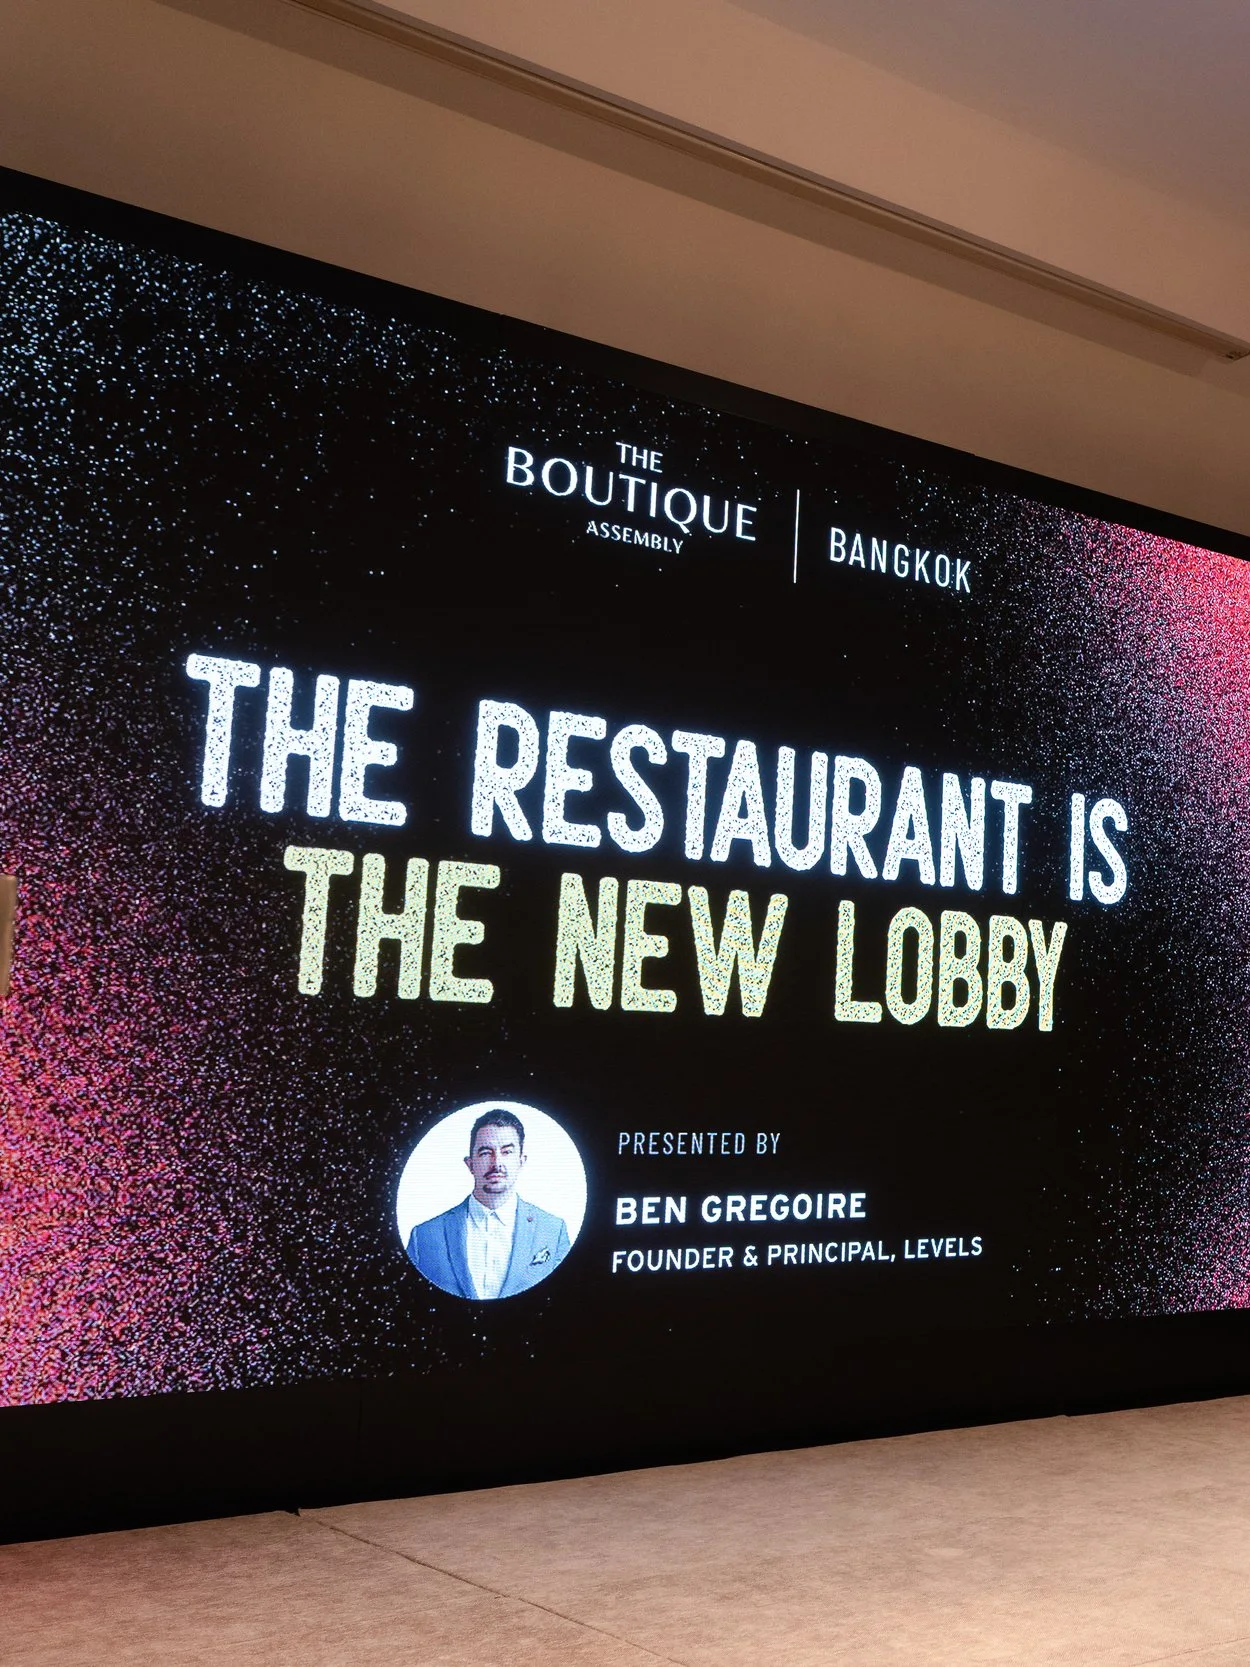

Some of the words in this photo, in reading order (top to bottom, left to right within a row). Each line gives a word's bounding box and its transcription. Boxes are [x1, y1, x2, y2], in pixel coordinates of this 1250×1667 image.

[615, 441, 663, 473] THE
[506, 446, 757, 541] BOUTIQUE
[586, 520, 683, 554] ASSEMBLY
[829, 526, 972, 593] BANGKOK
[185, 653, 415, 827] THE
[470, 698, 1033, 895] RESTAURANT
[1068, 792, 1129, 904] IS
[283, 845, 500, 1003] THE
[552, 872, 789, 1018] NEW
[833, 899, 1068, 1032] LOBBY
[618, 1132, 745, 1155] PRESENTED
[756, 1132, 781, 1155] BY
[615, 1196, 687, 1225] BEN
[701, 1192, 867, 1223] GREGOIRE
[612, 1246, 734, 1273] FOUNDER
[743, 1246, 759, 1267] &
[767, 1240, 896, 1266] PRINCIPAL,
[904, 1236, 983, 1260] LEVELS
